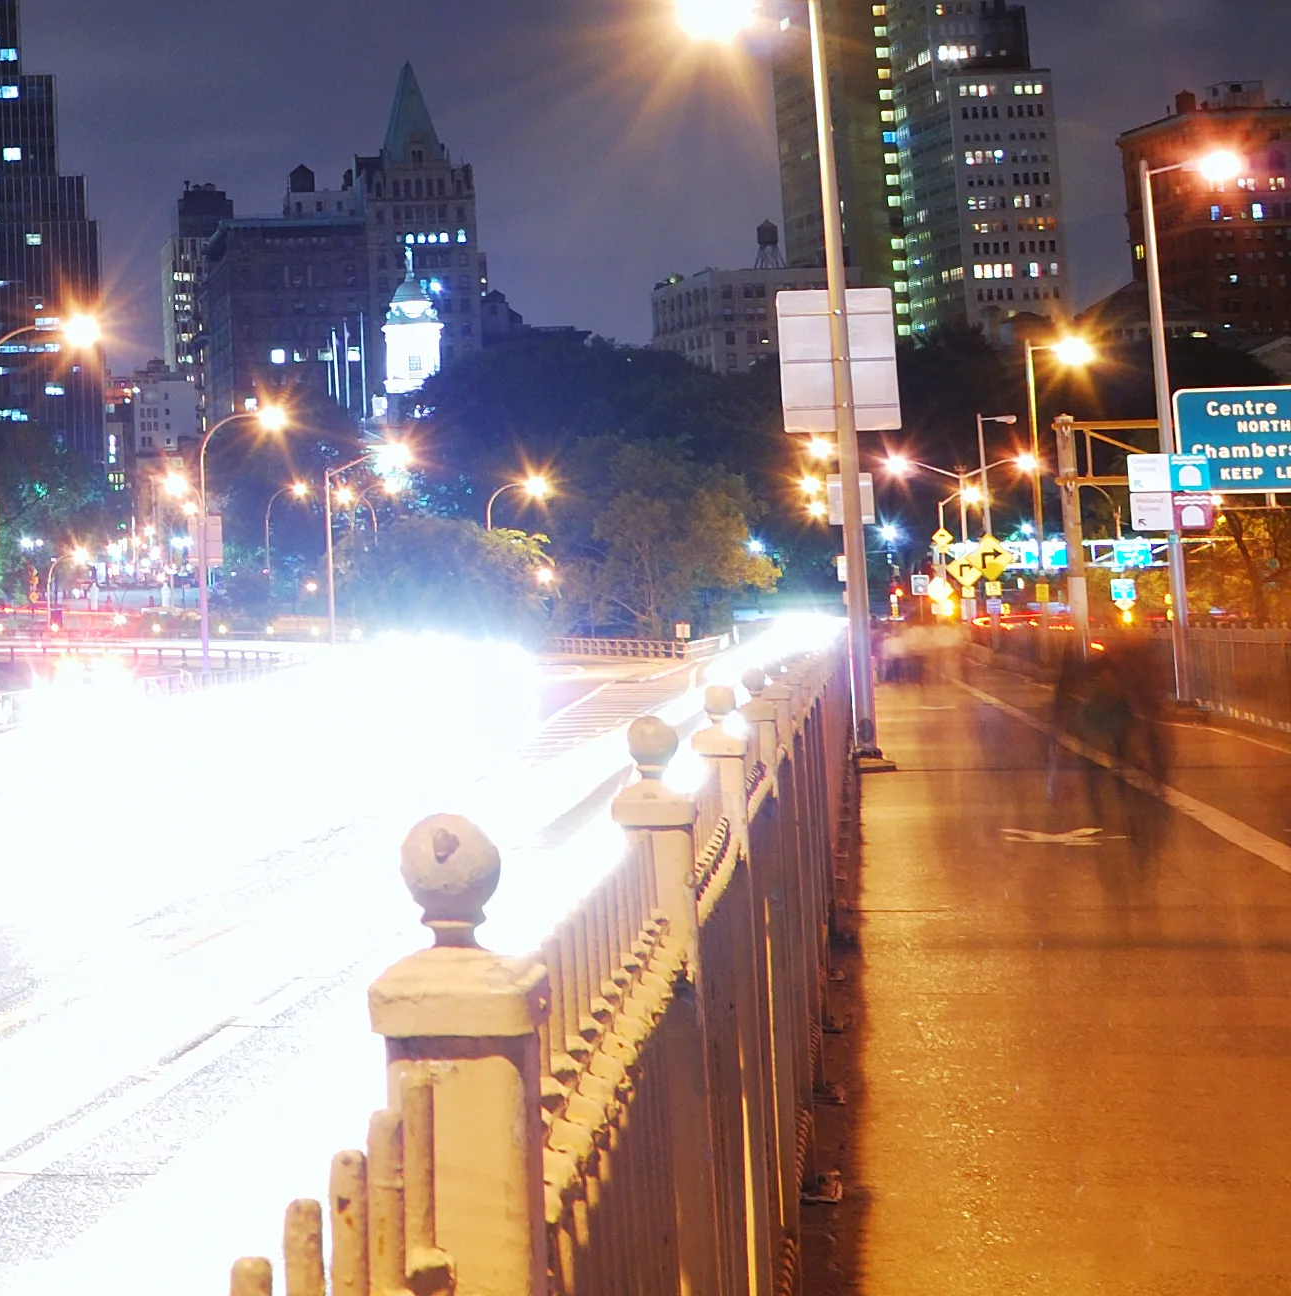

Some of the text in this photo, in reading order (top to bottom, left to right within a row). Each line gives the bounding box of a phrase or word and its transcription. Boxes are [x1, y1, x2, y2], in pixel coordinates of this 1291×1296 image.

[1206, 400, 1278, 417] Centre
[1237, 419, 1291, 433] NORTH
[1220, 466, 1264, 480] KEEP
